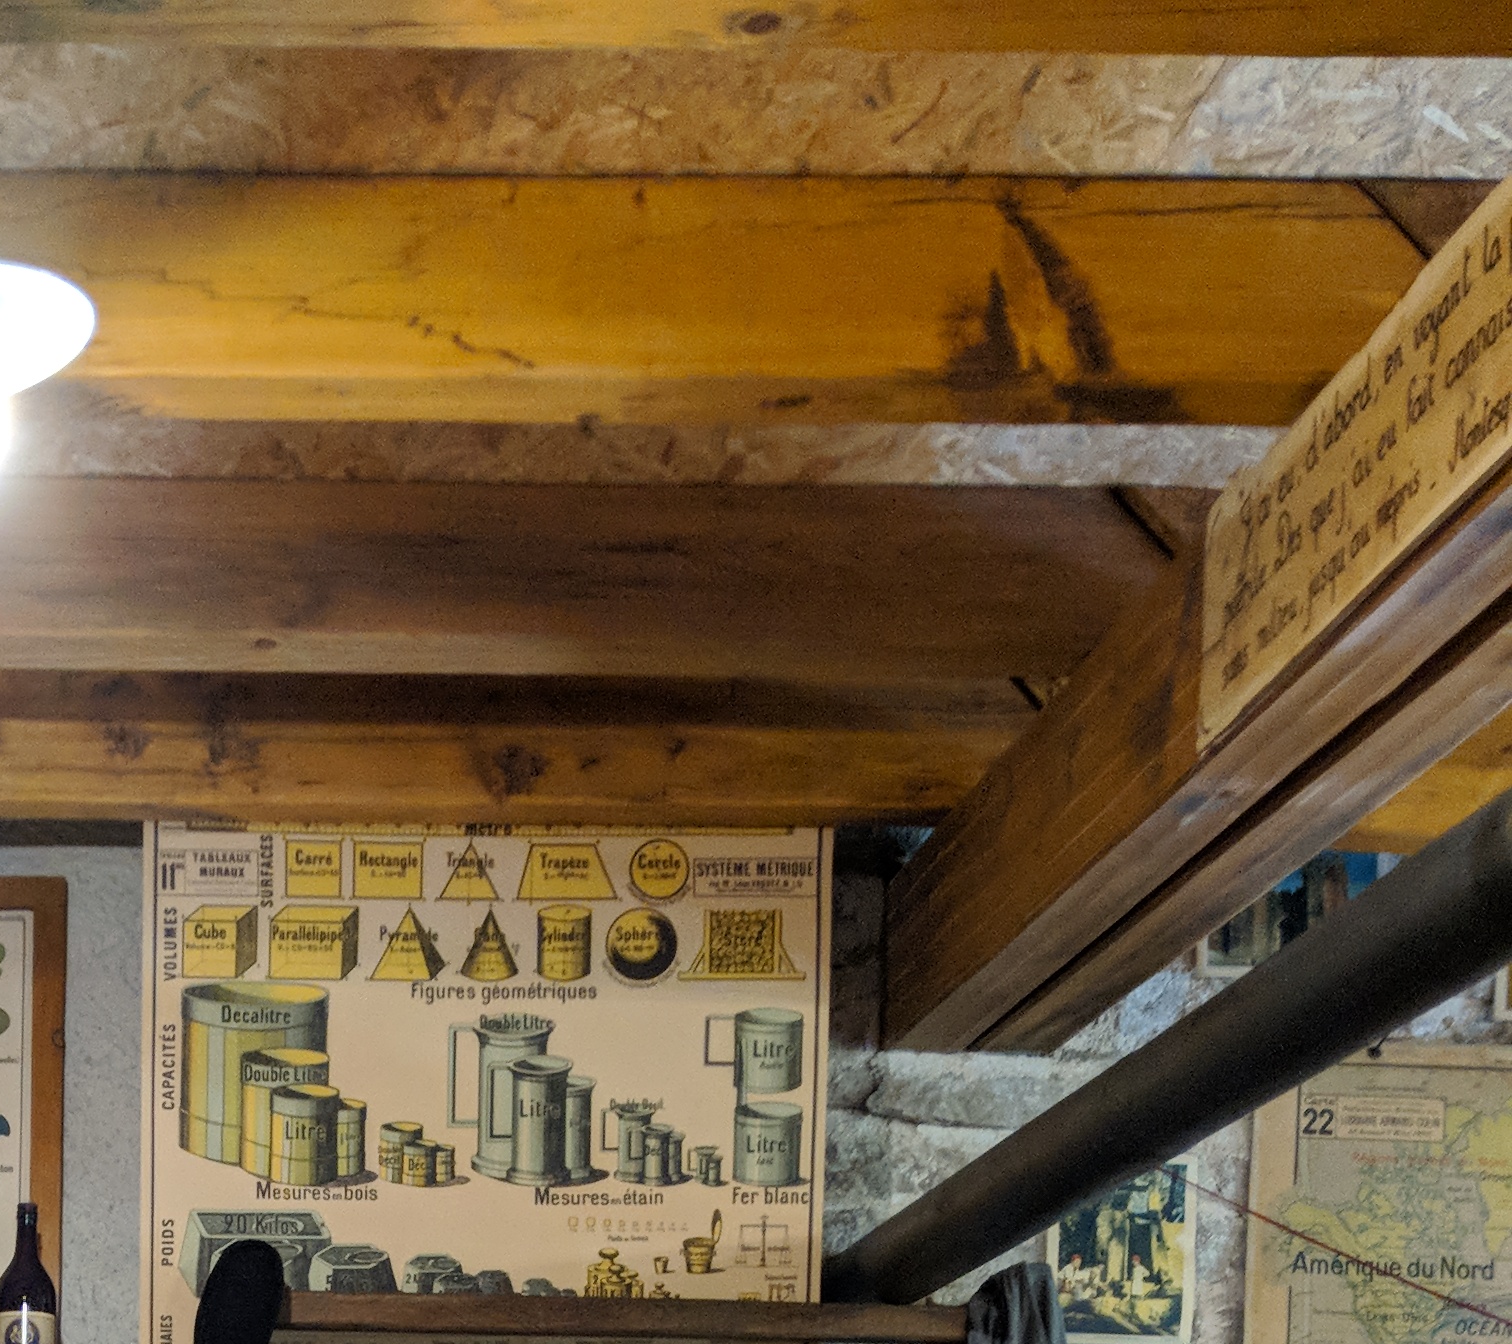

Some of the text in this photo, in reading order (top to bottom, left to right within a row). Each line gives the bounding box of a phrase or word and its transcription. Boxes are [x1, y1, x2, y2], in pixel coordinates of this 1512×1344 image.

[1384, 345, 1403, 385] en
[1414, 248, 1471, 366] voyant
[1484, 224, 1502, 273] la
[193, 852, 251, 862] TABLEAUX
[295, 850, 333, 866] Carré
[359, 851, 418, 869] Rectangle
[447, 852, 494, 870] Triangle
[540, 853, 589, 869] Trapèze
[638, 853, 680, 870] Cercle
[199, 867, 245, 877] MURAUX
[260, 835, 273, 908] SURFACES
[696, 860, 814, 878] SYSTÈME MÉTRIQUE
[194, 924, 226, 940] Cube
[164, 907, 177, 982] VOLUMES
[411, 983, 597, 1005] Figures géométriques
[480, 1013, 554, 1030] Double Litre
[753, 1040, 795, 1058] Litre
[162, 1024, 176, 1110] CAPACITÉS
[244, 1063, 290, 1082] Double
[520, 1099, 561, 1118] Litre
[285, 1121, 326, 1140] Litre
[1303, 1108, 1334, 1135] 22
[746, 1135, 787, 1153] Litre
[256, 1182, 378, 1201] Mesures bois
[535, 1188, 664, 1205] Mesures étain
[732, 1187, 810, 1204] Fer blanc
[224, 1214, 299, 1234] 20 Kilos
[162, 1218, 174, 1267] POIDS
[1292, 1252, 1495, 1282] Amérique du Nord
